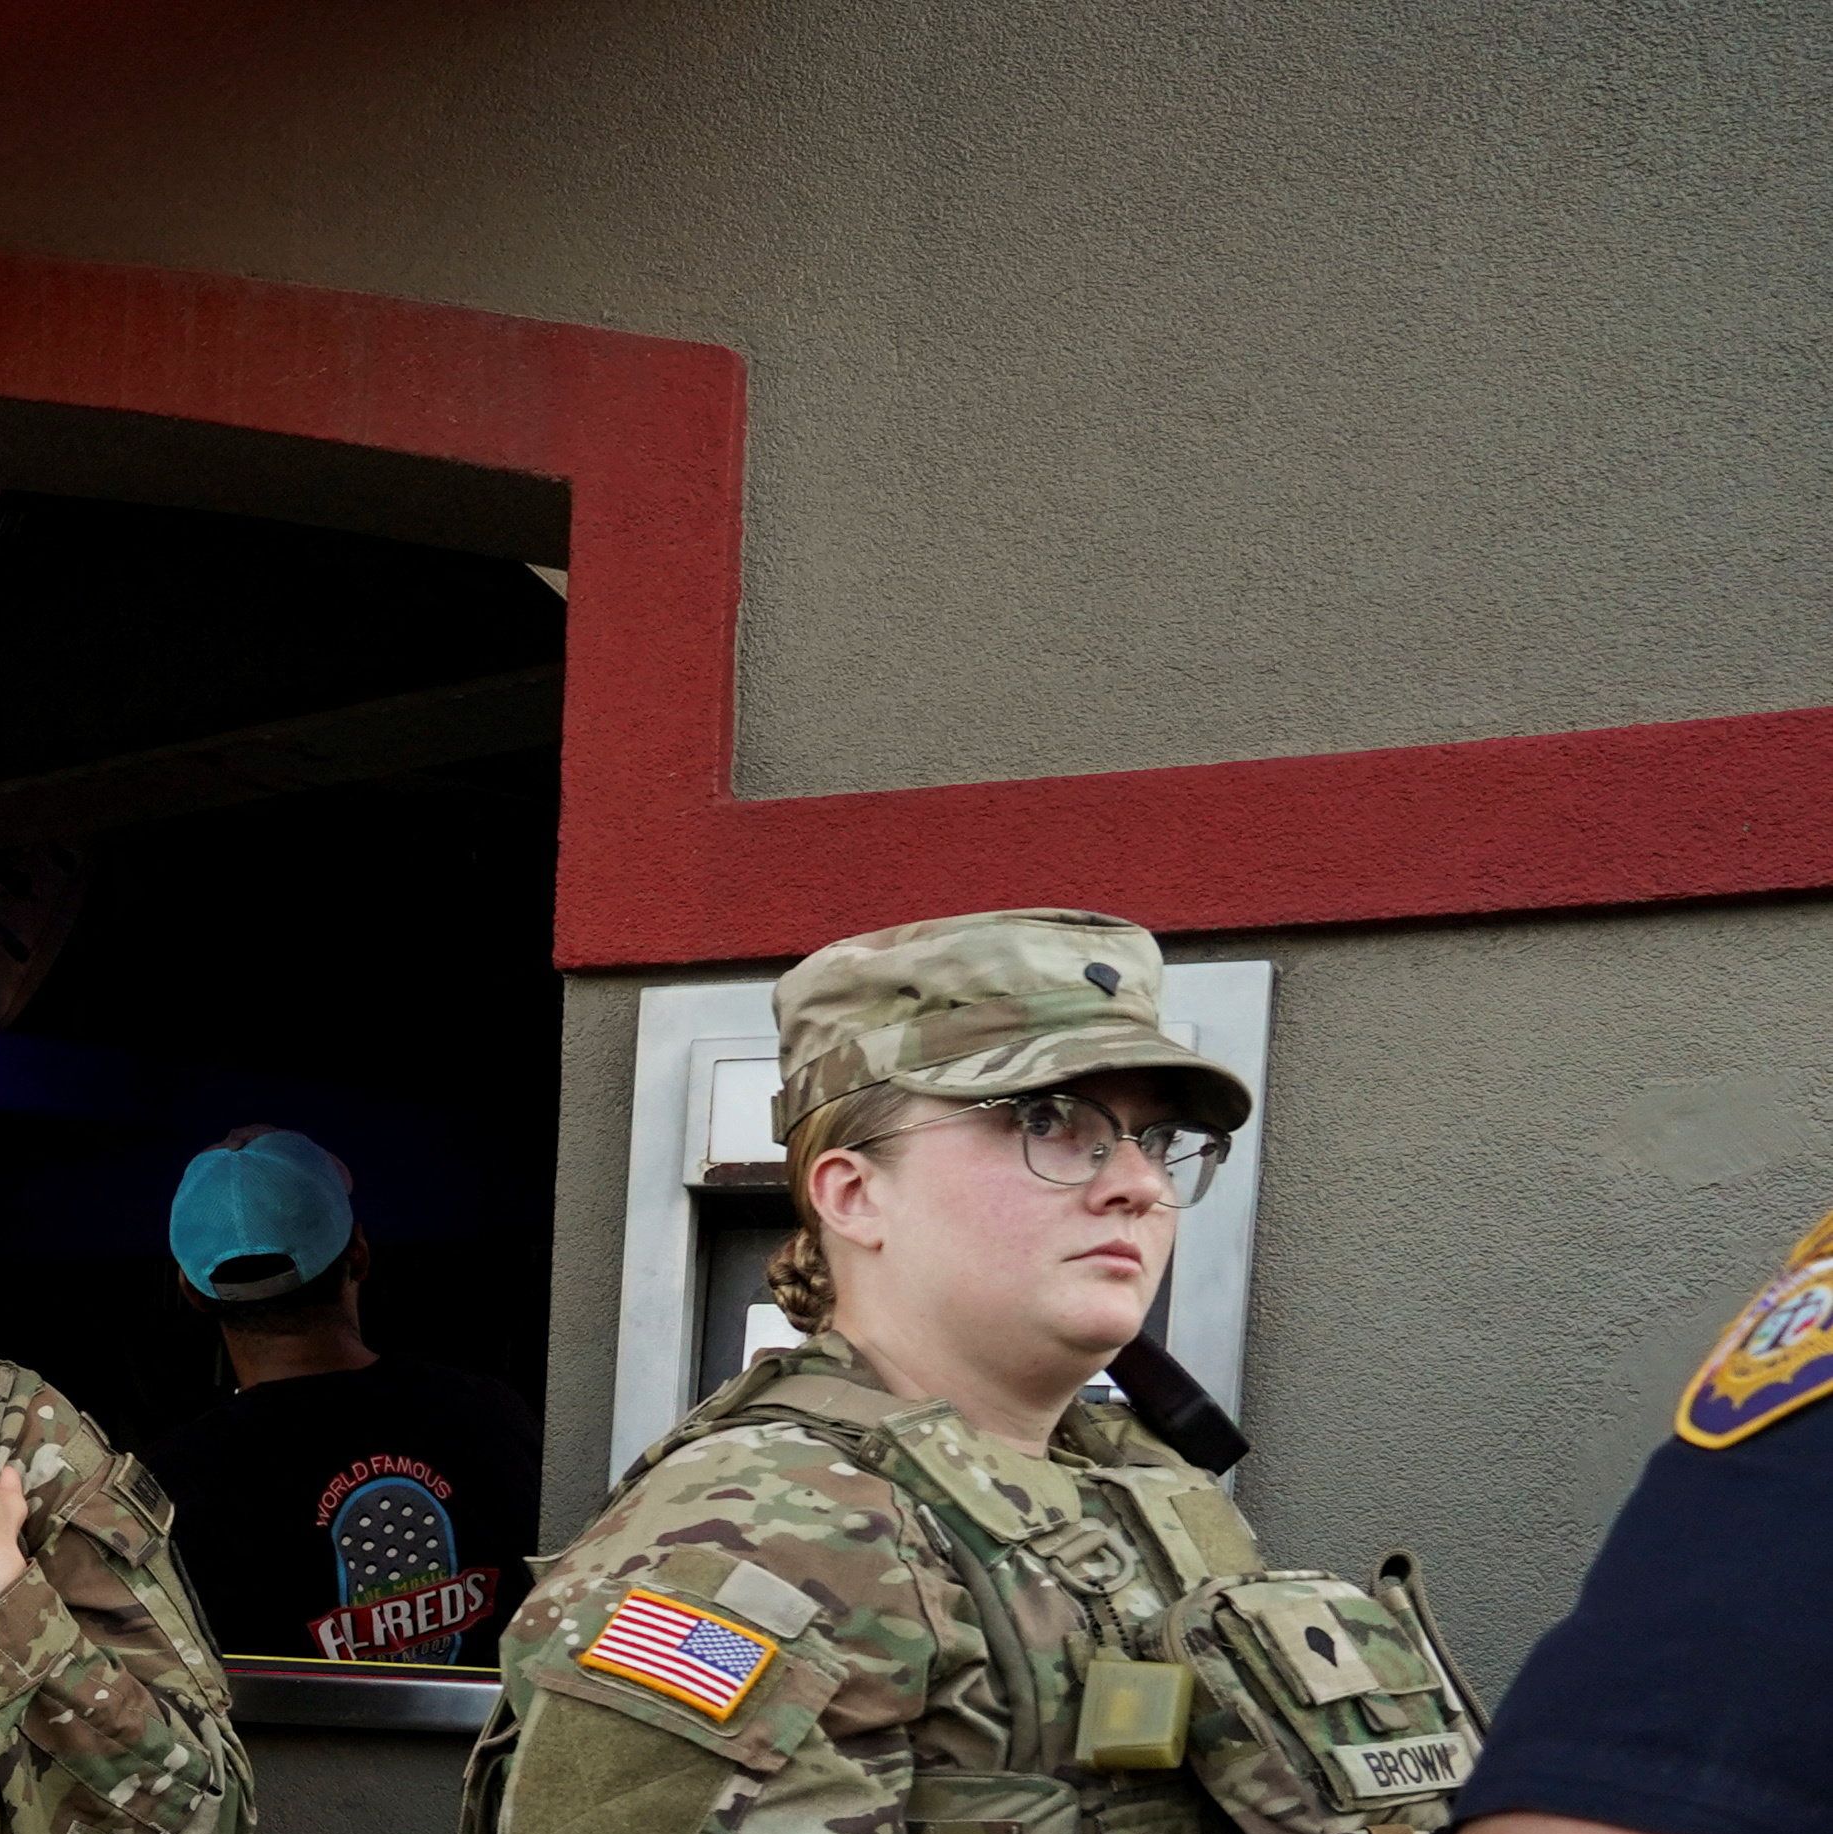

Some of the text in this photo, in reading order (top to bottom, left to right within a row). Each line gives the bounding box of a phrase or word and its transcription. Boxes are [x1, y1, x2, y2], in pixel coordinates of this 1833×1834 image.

[316, 1455, 452, 1527] WORLD FAMOUS
[1361, 1743, 1456, 1788] BROWN
